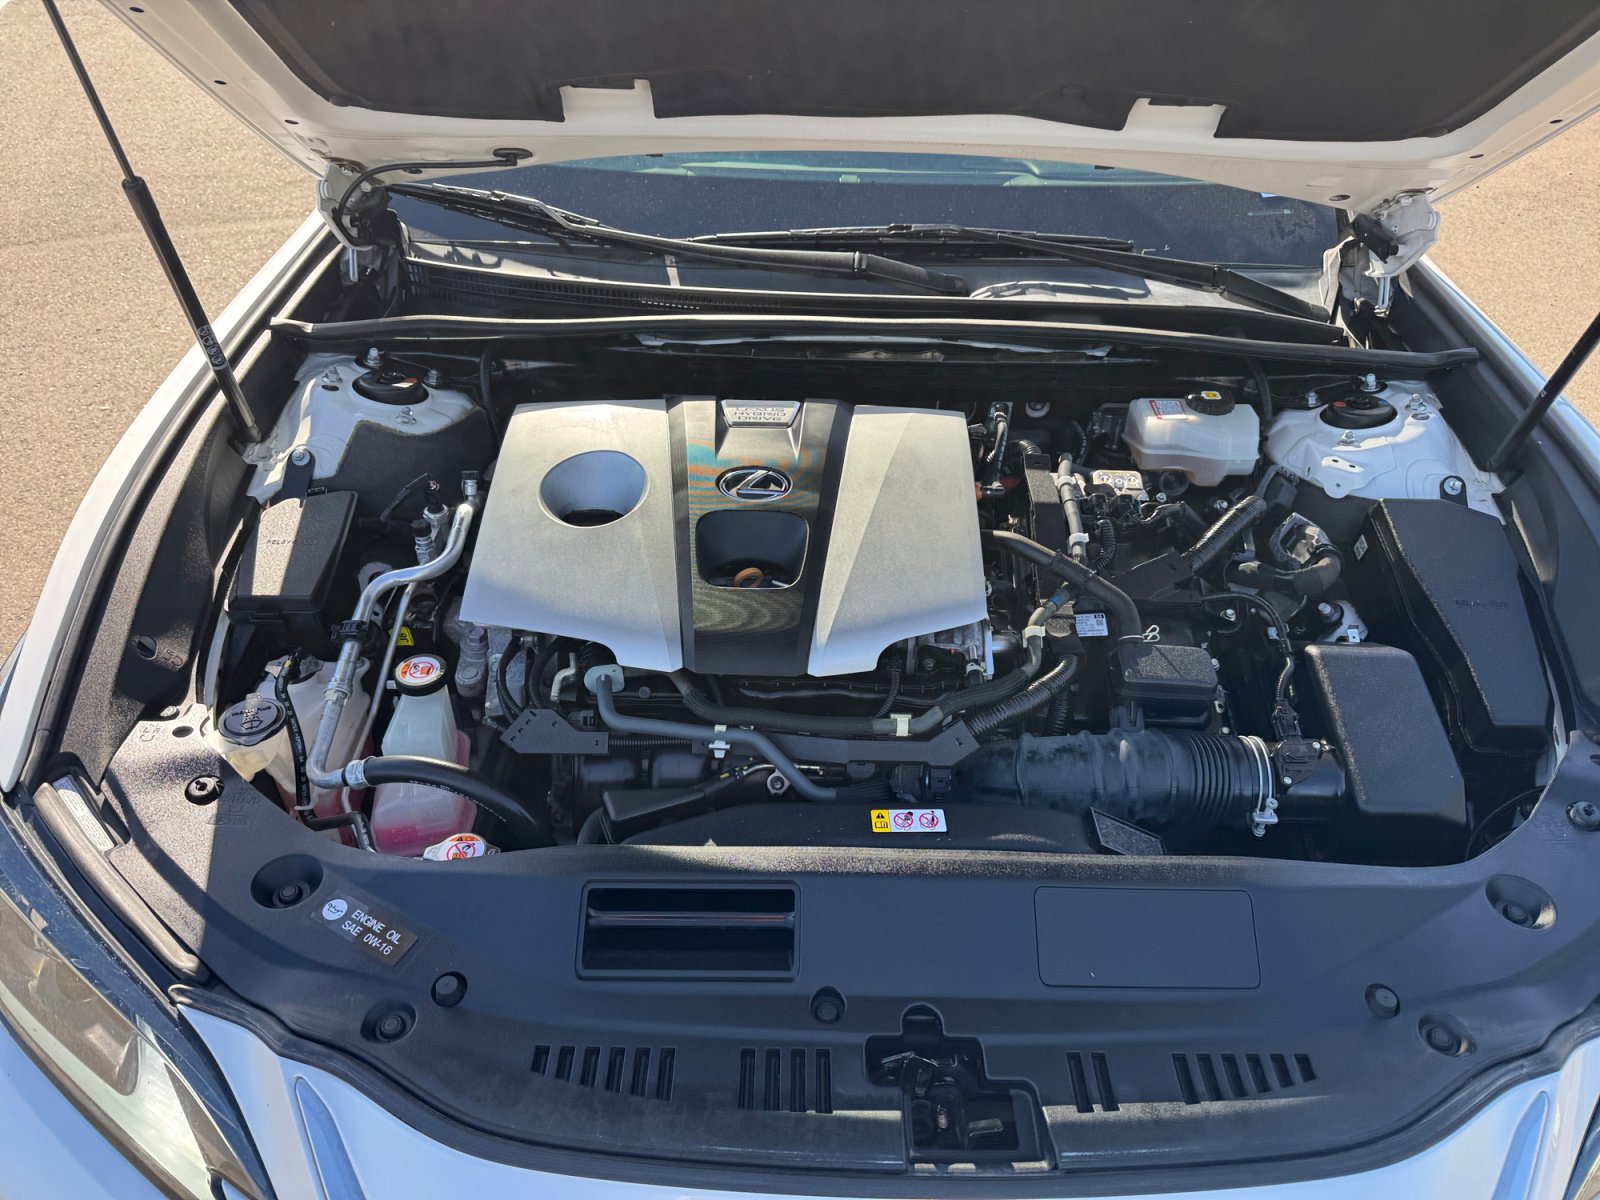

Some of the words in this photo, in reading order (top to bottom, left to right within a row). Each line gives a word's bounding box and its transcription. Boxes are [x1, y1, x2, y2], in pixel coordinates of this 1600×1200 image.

[341, 920, 363, 936] SAE
[363, 933, 393, 955] 0W-16
[351, 909, 386, 933] ENGINE
[386, 930, 402, 945] OIL
